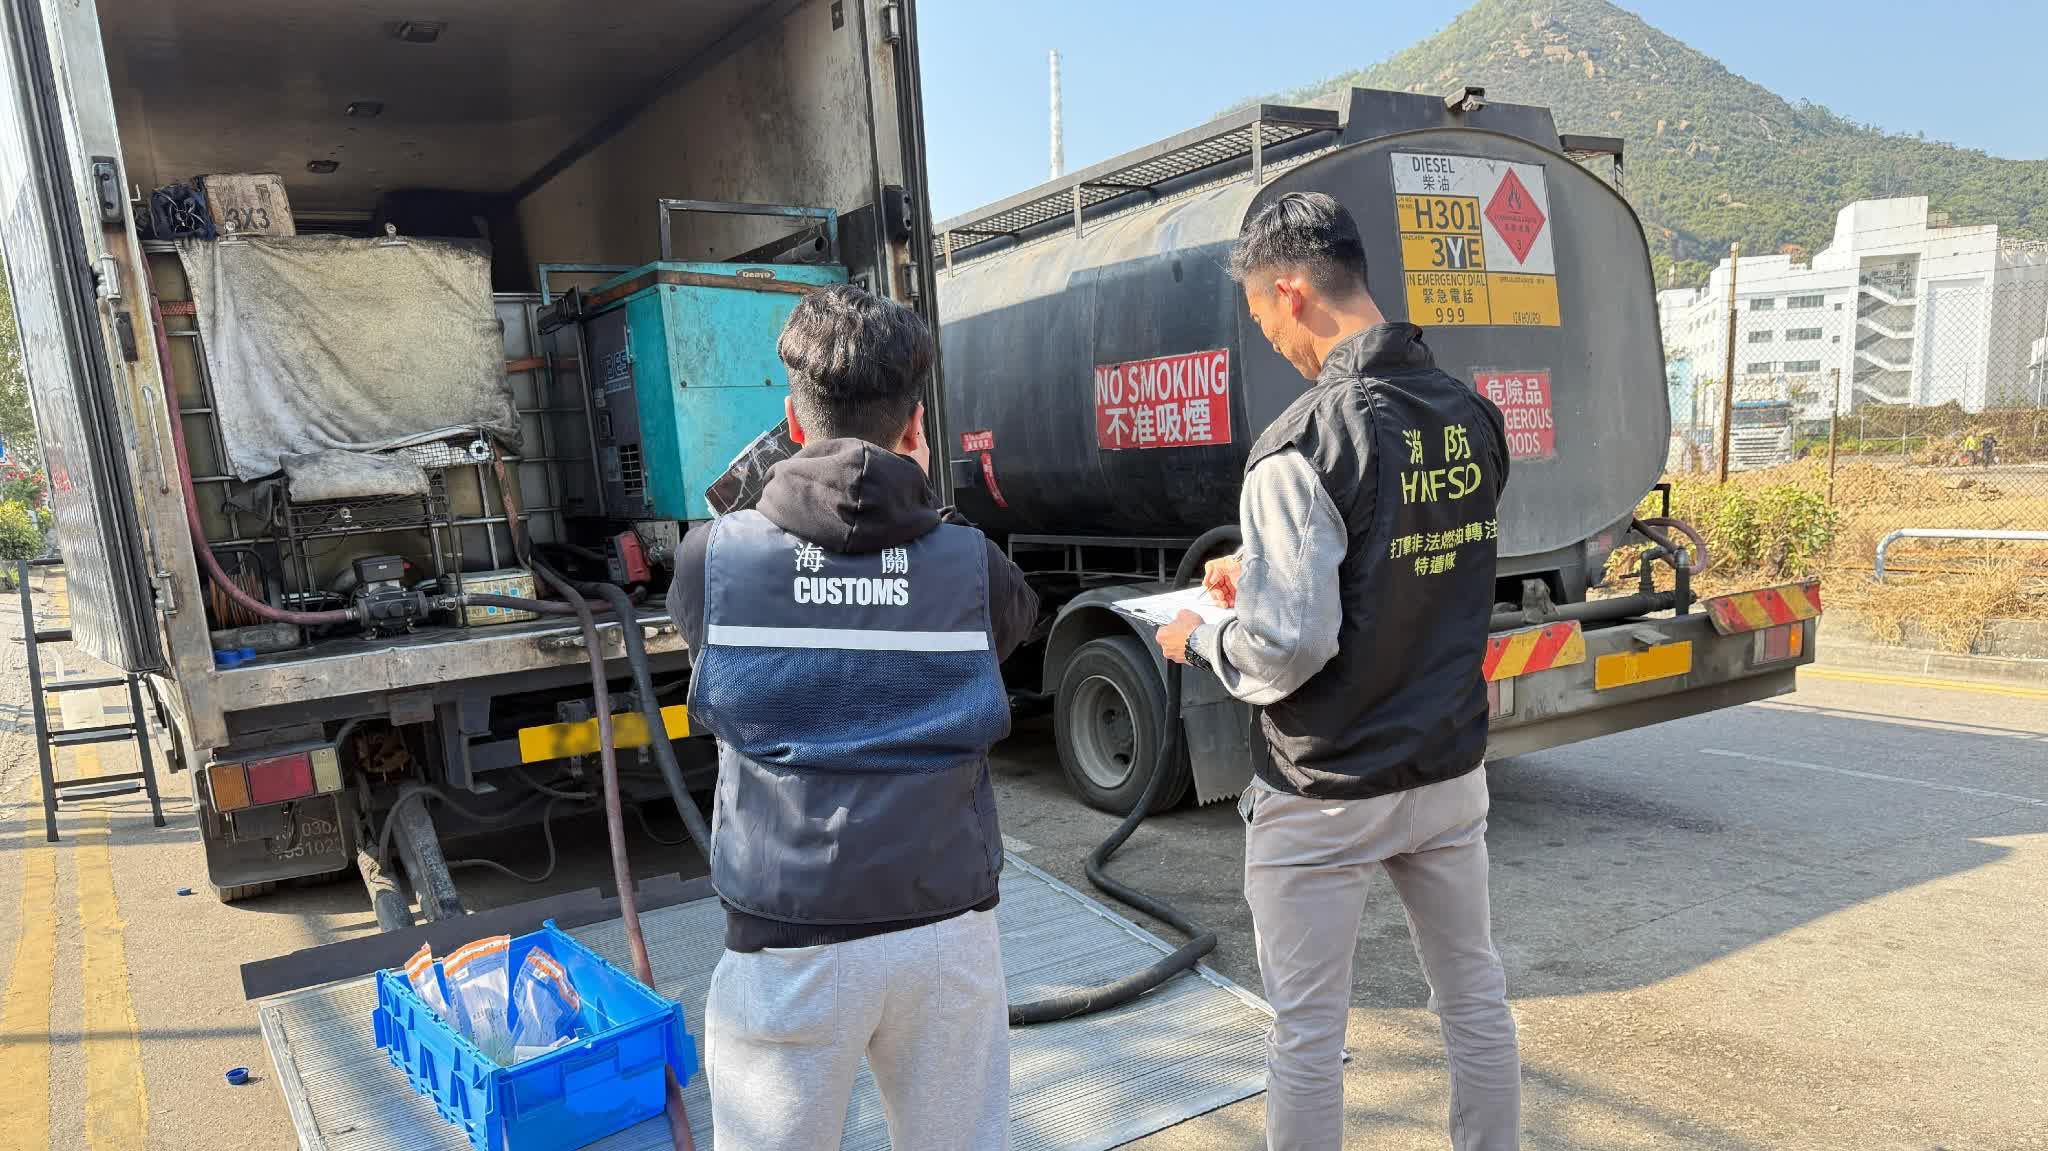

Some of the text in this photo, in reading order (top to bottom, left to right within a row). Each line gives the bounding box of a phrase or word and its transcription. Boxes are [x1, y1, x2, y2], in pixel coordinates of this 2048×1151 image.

[1412, 156, 1455, 174] DIESEL
[1423, 175, 1449, 192] 柴油
[1414, 198, 1480, 231] H301
[1431, 237, 1482, 269] 3YE
[1407, 275, 1418, 285] IN
[1418, 274, 1467, 286] EMERGENCY
[1468, 275, 1486, 287] DIAL
[1422, 288, 1473, 304] 緊急電話
[1436, 307, 1465, 323] 999
[1096, 353, 1226, 405] NO SMOKING
[1485, 377, 1544, 405] 危險品
[1105, 399, 1213, 446] 不准吸煙
[1504, 407, 1553, 430] GEROUS
[1505, 432, 1542, 454] OODS
[794, 542, 909, 575] 海關
[793, 577, 909, 606] CUSTOMS
